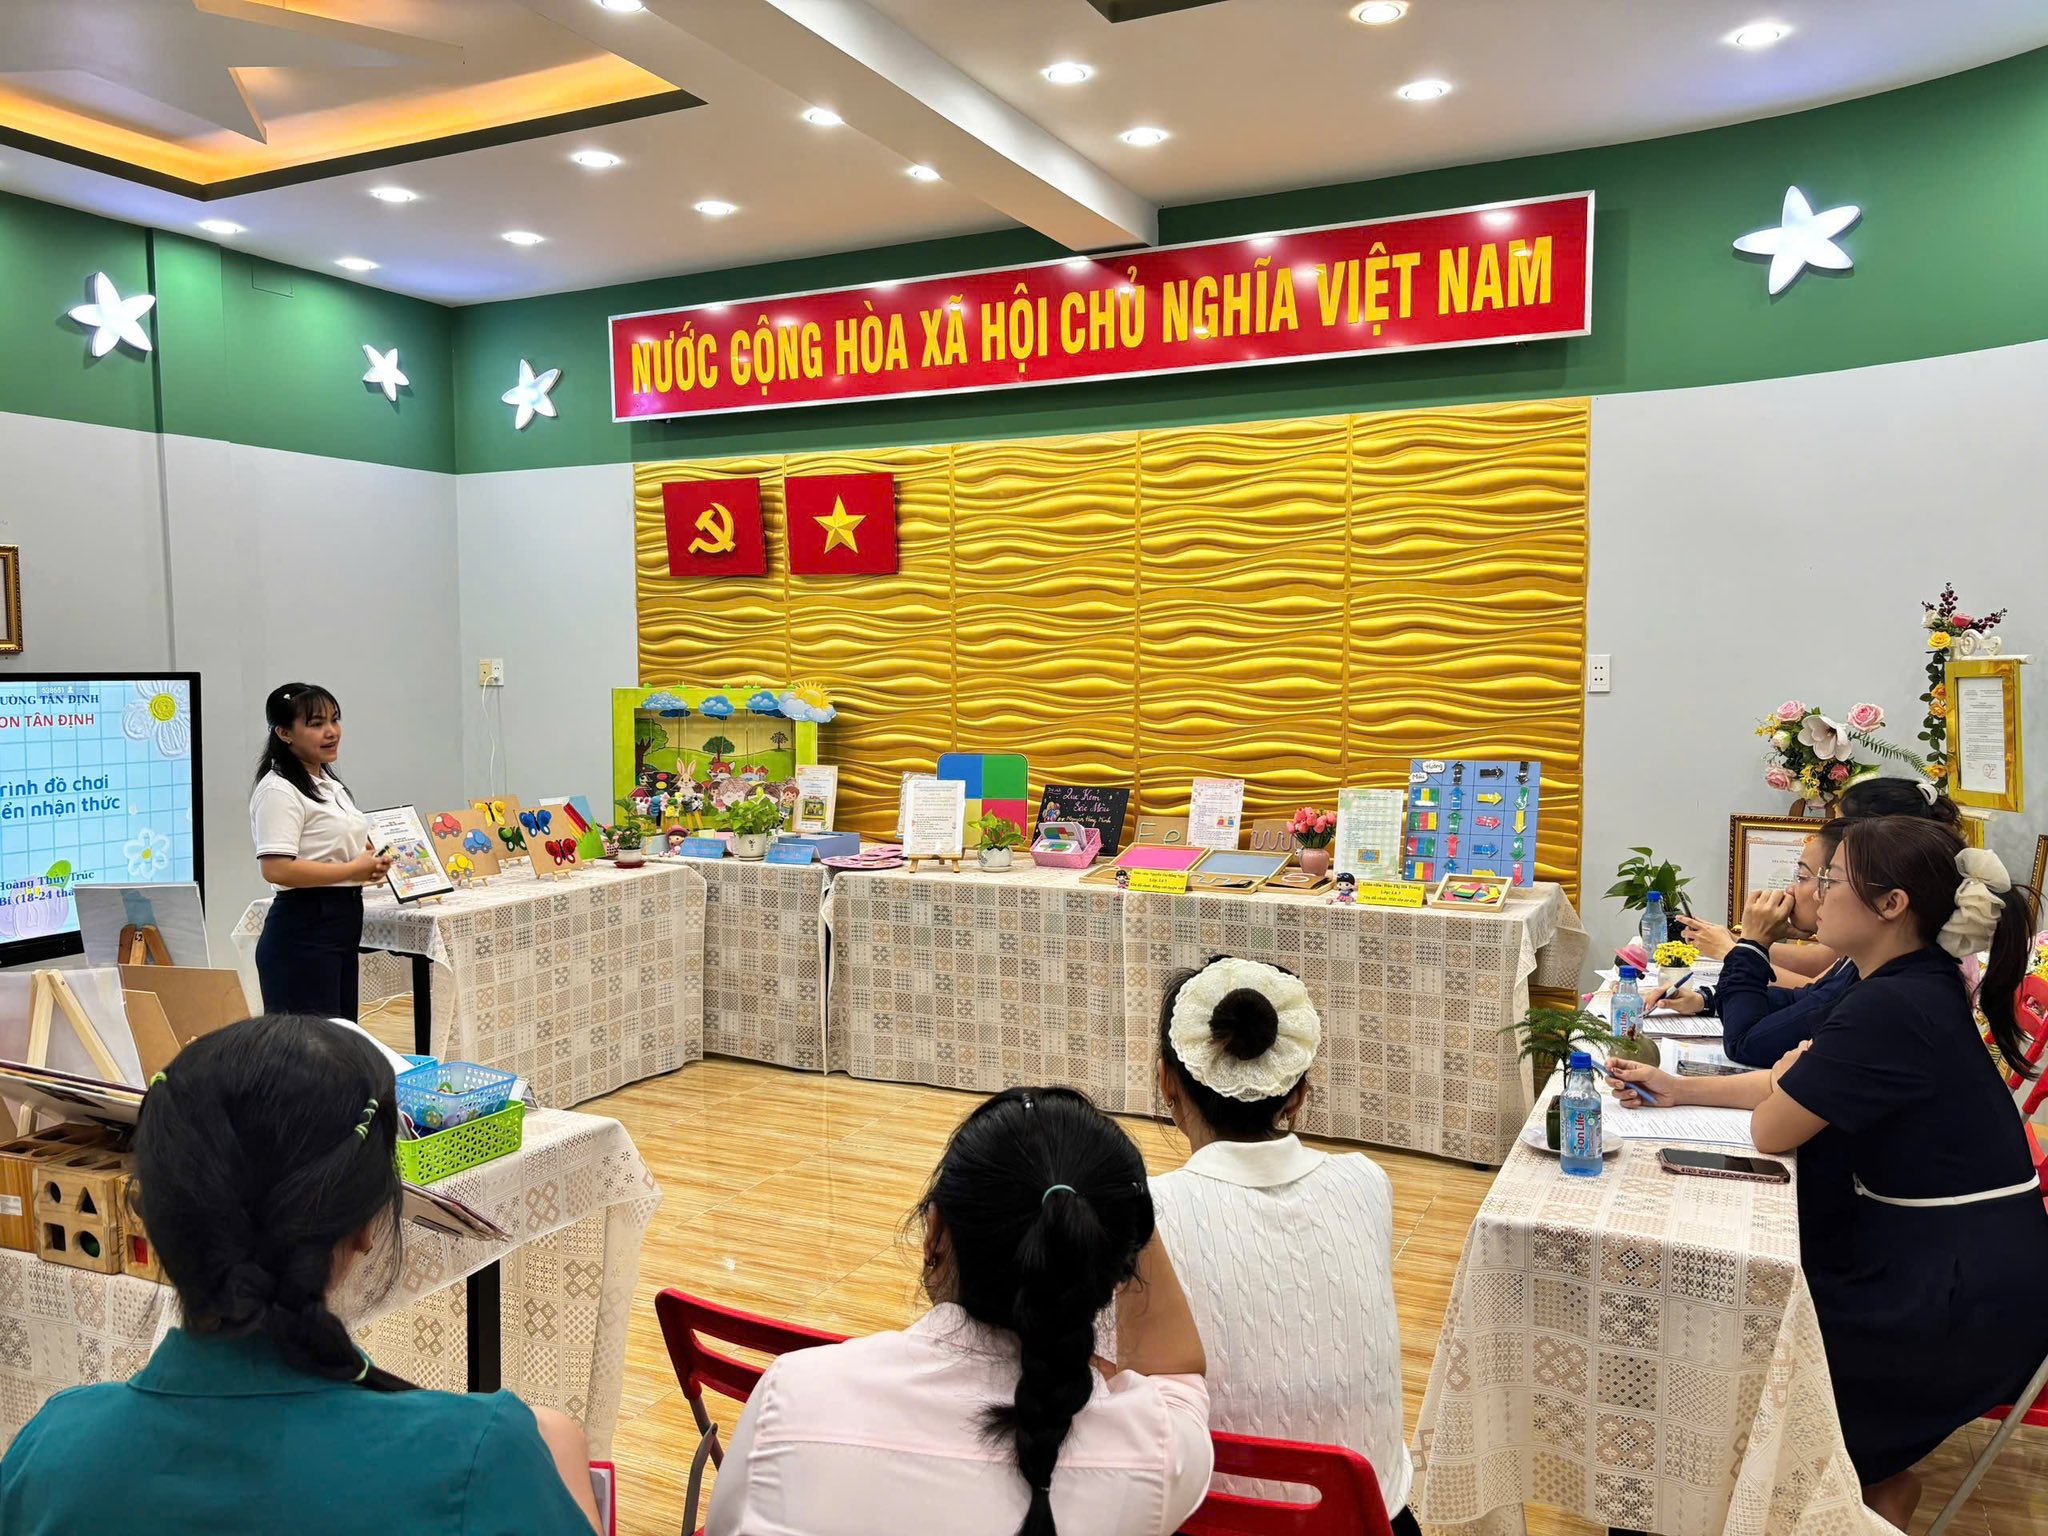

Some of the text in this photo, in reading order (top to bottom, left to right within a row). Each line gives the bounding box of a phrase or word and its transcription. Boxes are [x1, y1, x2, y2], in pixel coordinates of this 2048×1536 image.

[631, 235, 1553, 396] NƯỚC CỘNG HÒA XÃ HỘI CHỦ NGHĨA VIỆT NAM
[24, 712, 53, 727] TÂN
[58, 713, 95, 728] ĐỊNH
[0, 774, 108, 797] rình đồ chơi
[31, 799, 75, 817] nhận
[81, 796, 120, 812] thức
[1574, 1112, 1585, 1131] Life
